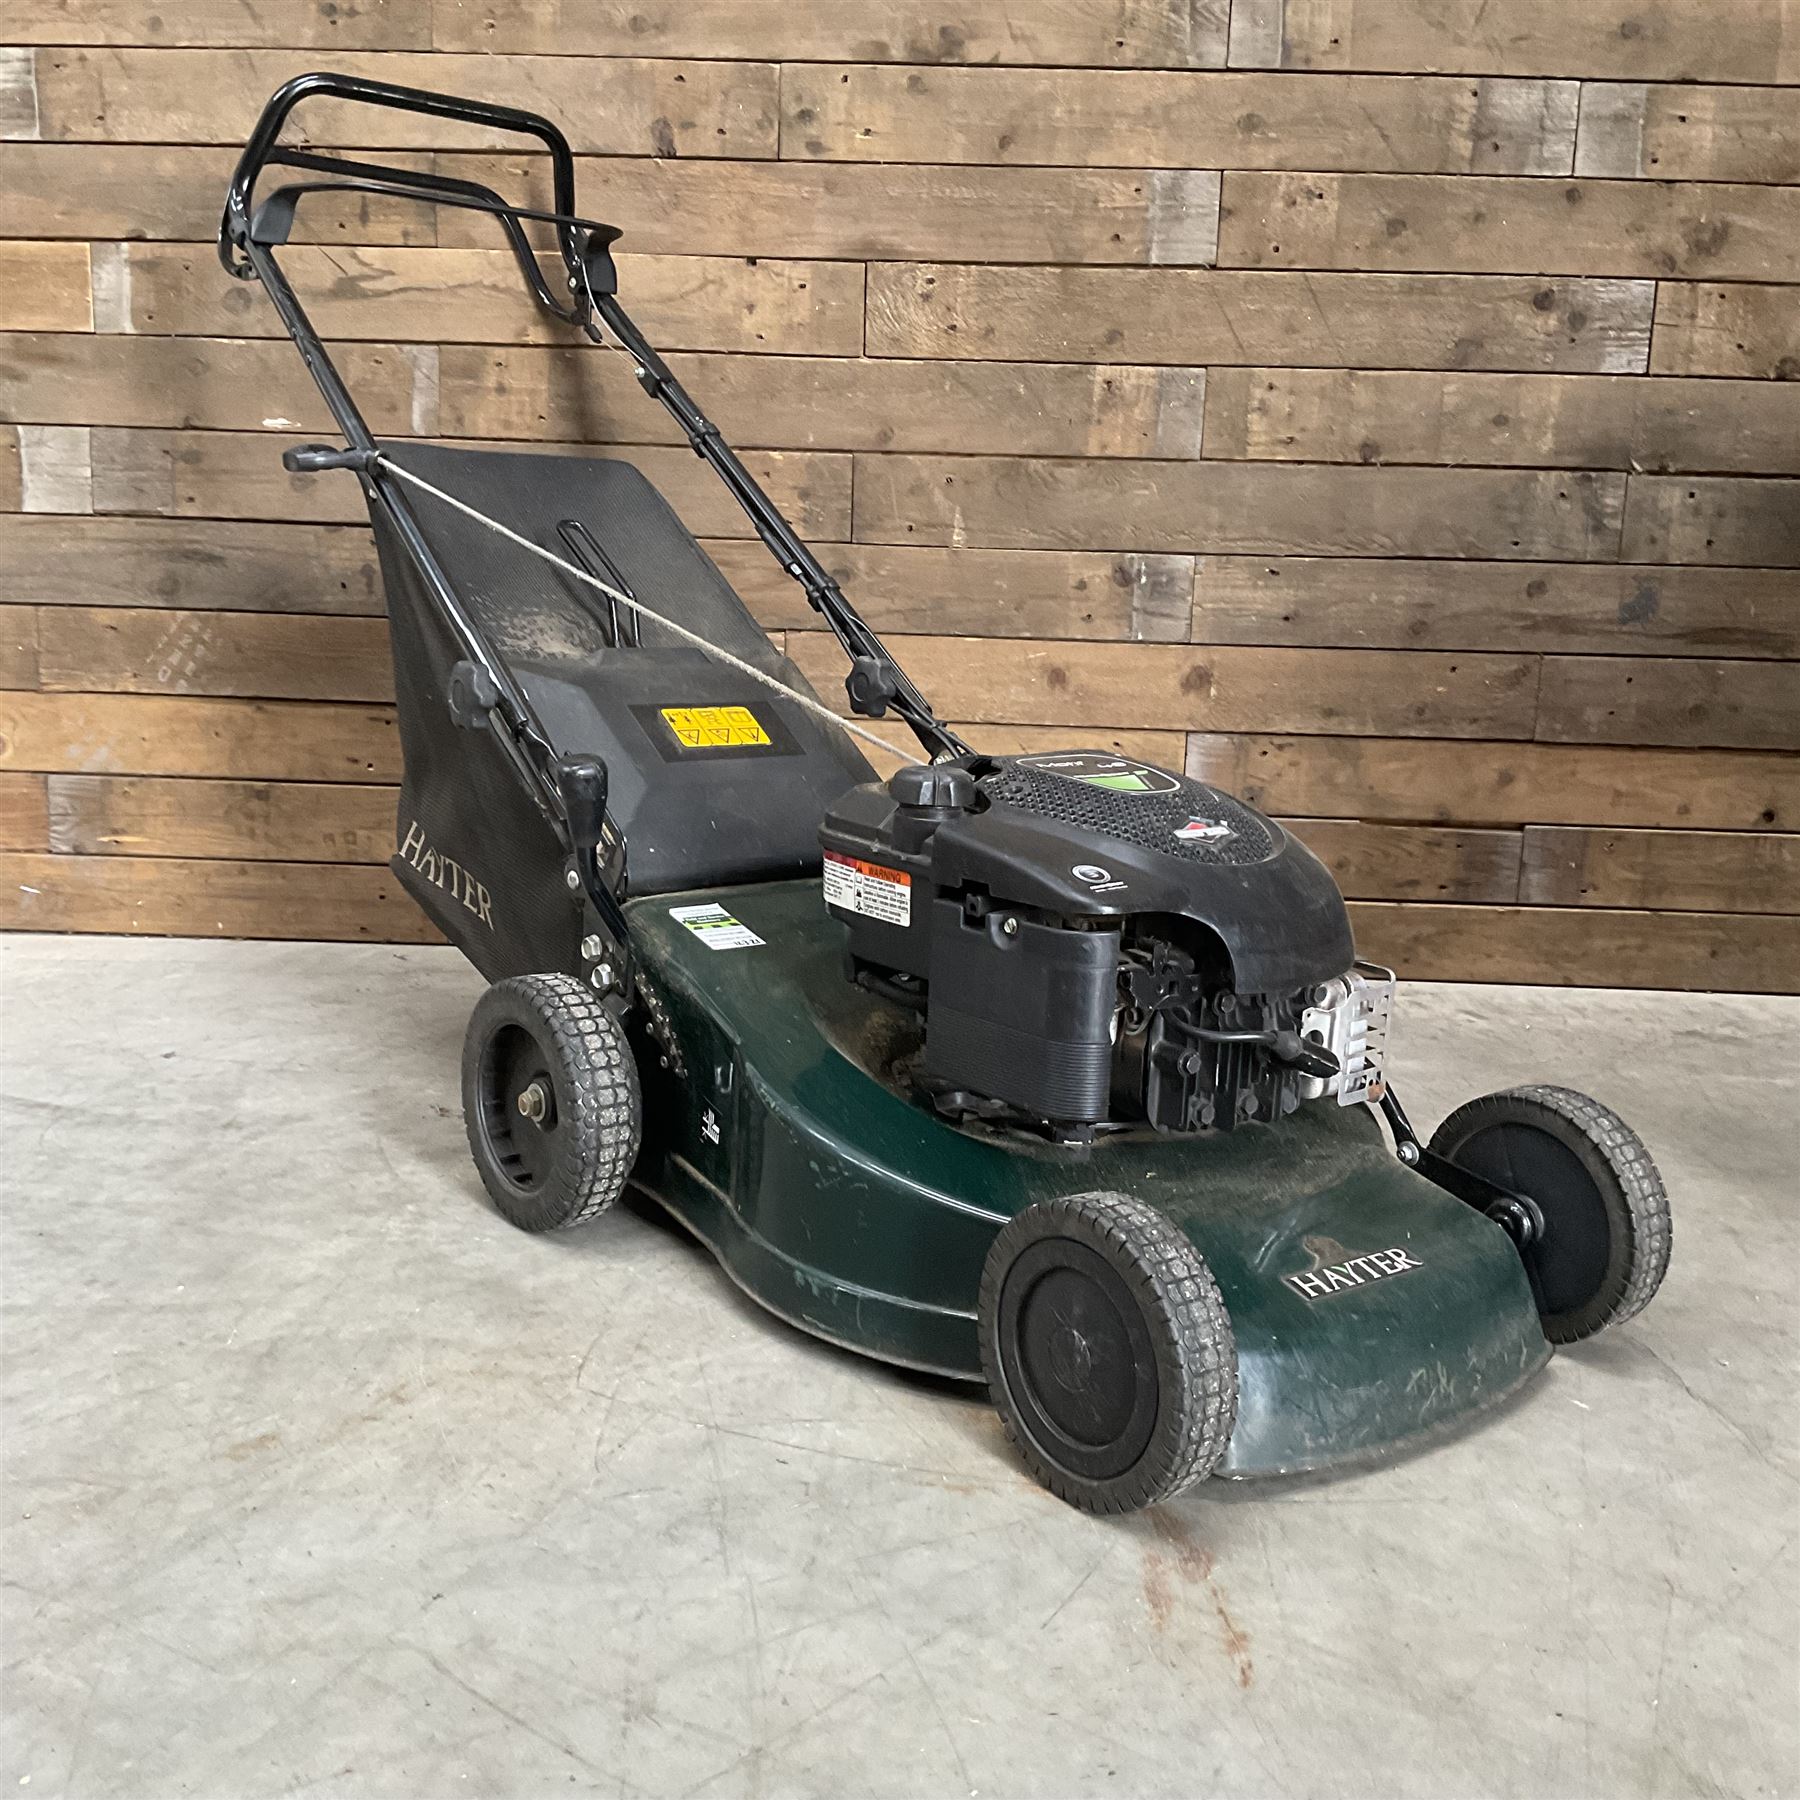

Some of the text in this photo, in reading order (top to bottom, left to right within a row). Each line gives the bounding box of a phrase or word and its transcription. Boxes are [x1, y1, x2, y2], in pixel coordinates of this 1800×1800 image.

[398, 820, 494, 931] HAYTER
[867, 865, 901, 884] WARNING
[1290, 1248, 1423, 1298] HAYTER
